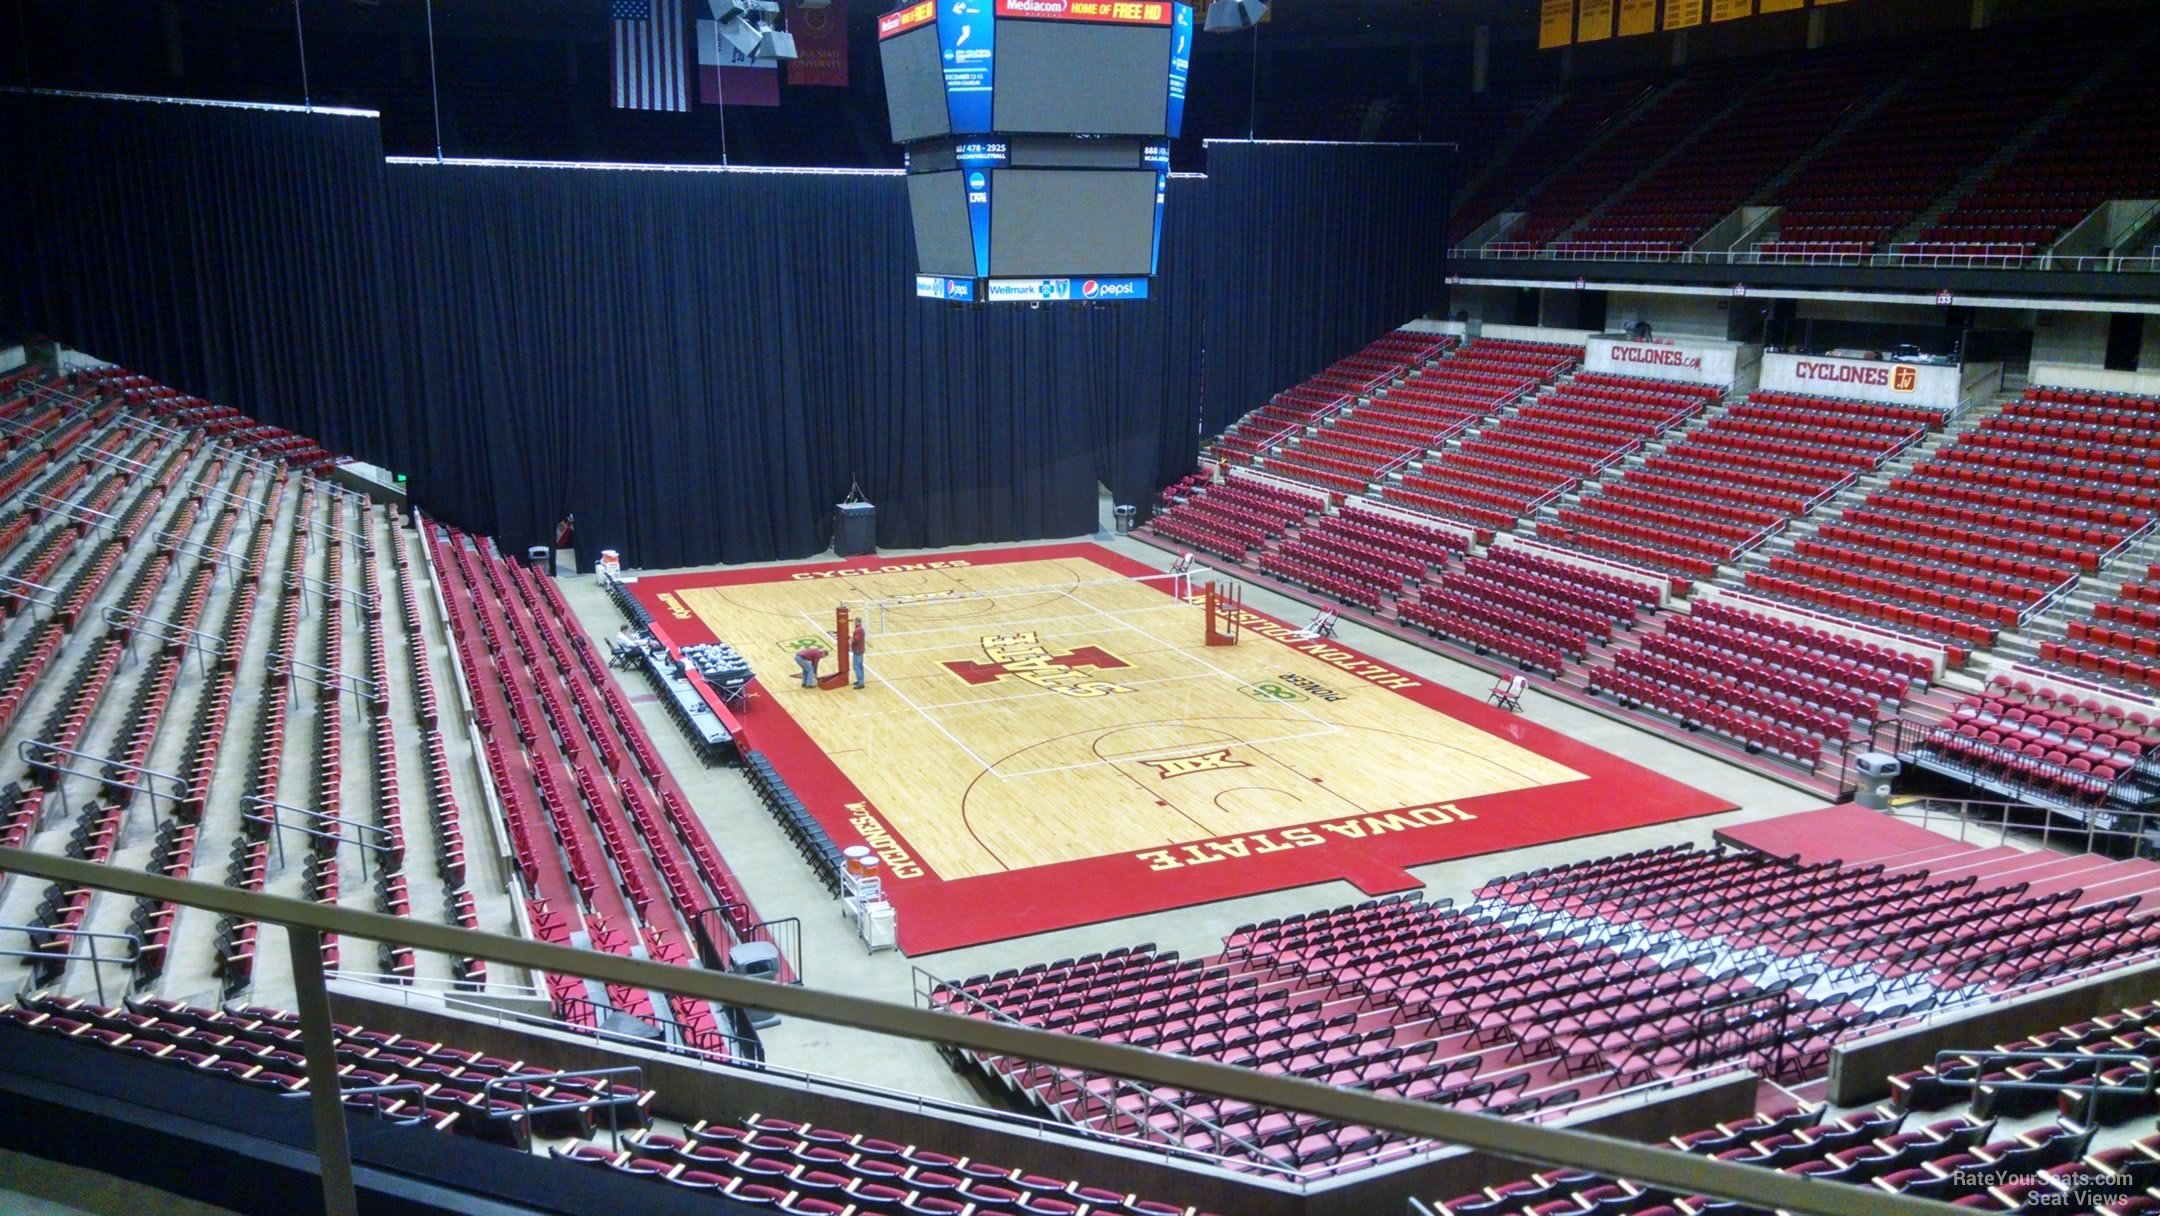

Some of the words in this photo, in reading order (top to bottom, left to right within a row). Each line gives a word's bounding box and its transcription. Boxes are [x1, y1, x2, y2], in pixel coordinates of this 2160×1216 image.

[1007, 0, 1062, 12] Mediacom
[1071, 2, 1098, 14] HOME
[1099, 5, 1112, 15] OF
[1112, 2, 1143, 19] FREE
[1143, 5, 1163, 20] HD
[967, 144, 982, 153] 478
[987, 144, 1007, 152] 2925
[990, 285, 1035, 295] Wellmark
[1100, 282, 1133, 296] pepsi
[1937, 296, 1951, 304] 133
[1796, 361, 1888, 386] CYCLONES
[791, 559, 972, 581] CYCLONES
[1298, 643, 1422, 690] HILTON
[1277, 671, 1348, 703] PIONEER
[1320, 803, 1478, 840] IOWA
[1136, 827, 1327, 872] STATE
